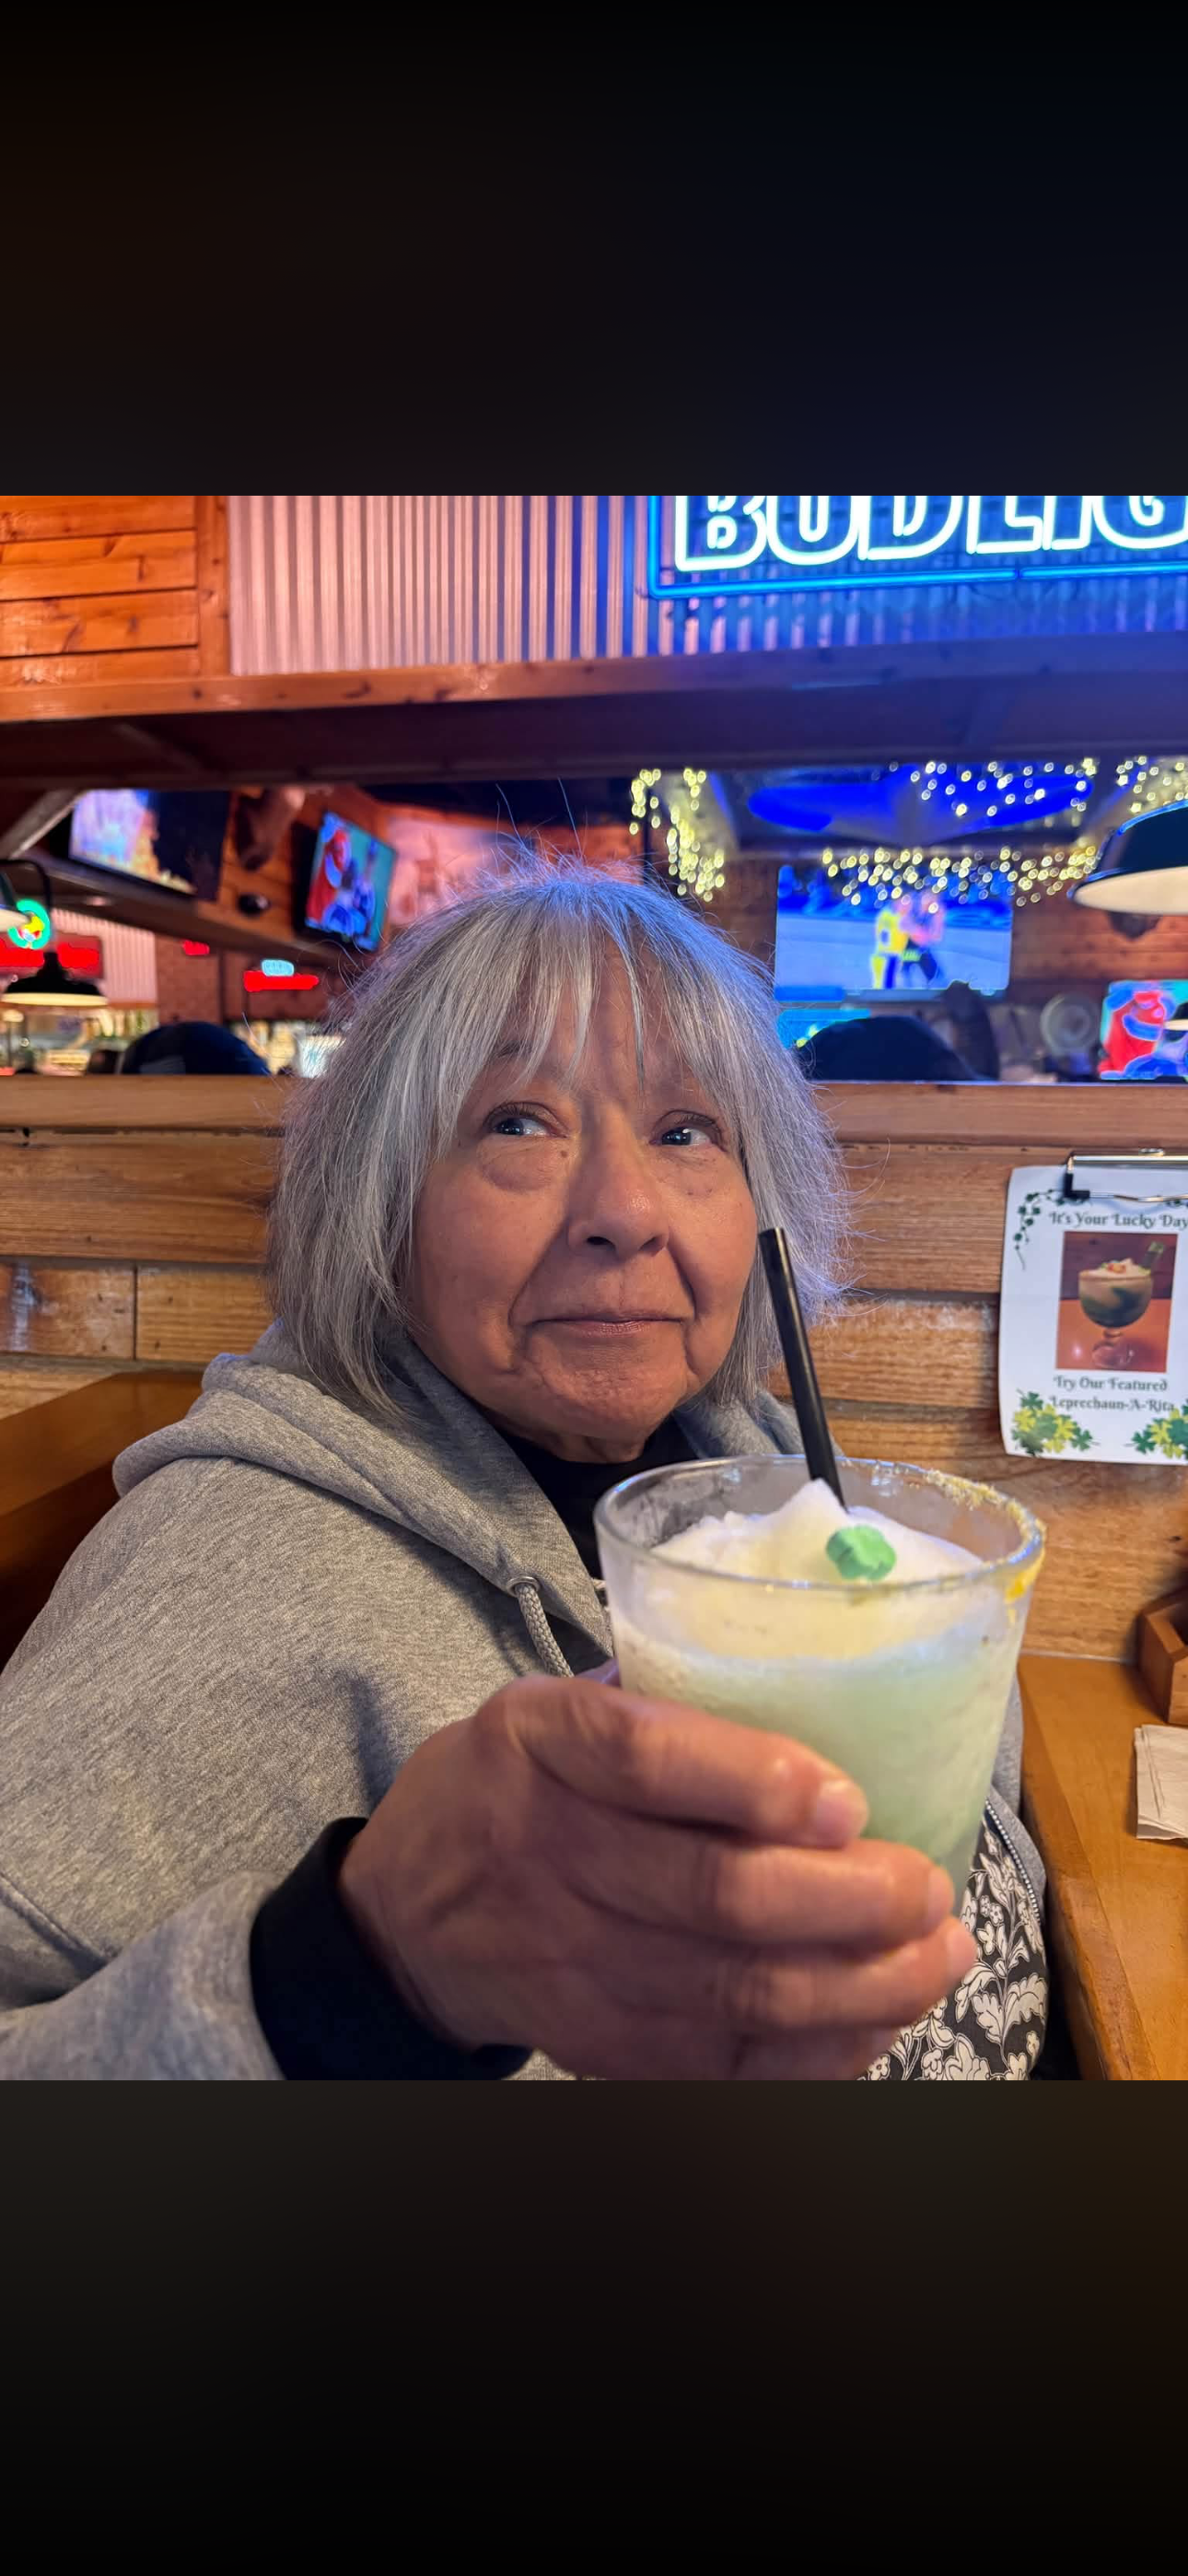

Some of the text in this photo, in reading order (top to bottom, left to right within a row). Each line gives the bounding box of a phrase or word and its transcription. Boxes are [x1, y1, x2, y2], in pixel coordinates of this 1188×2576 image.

[1050, 1212, 1070, 1224] It's
[1075, 1212, 1108, 1228] Your
[1112, 1213, 1155, 1229] Lucky
[1054, 1376, 1168, 1391] Try Our Featured
